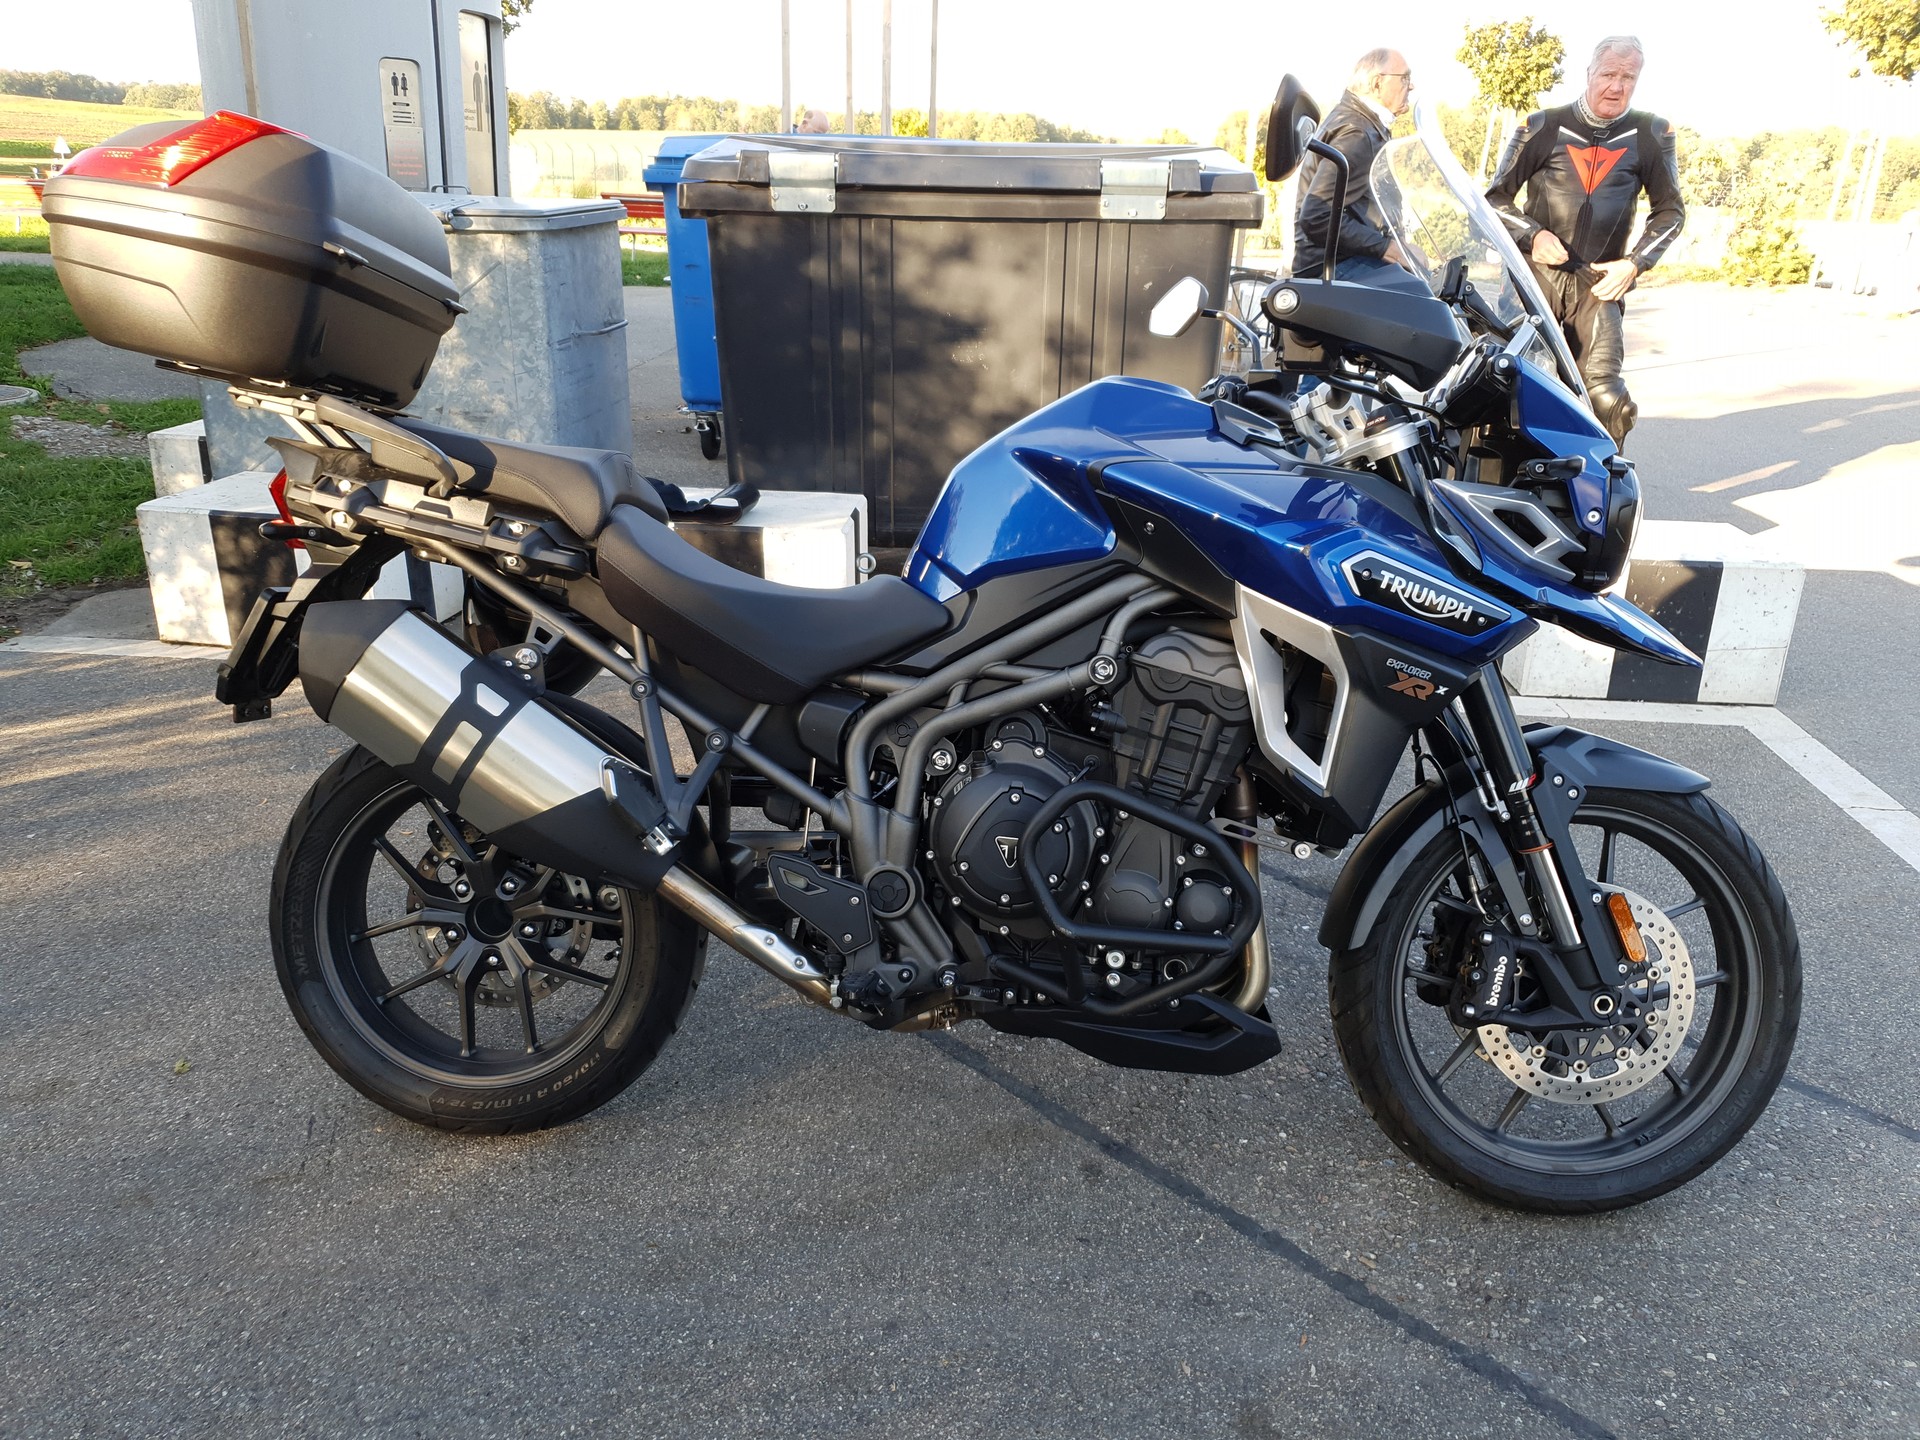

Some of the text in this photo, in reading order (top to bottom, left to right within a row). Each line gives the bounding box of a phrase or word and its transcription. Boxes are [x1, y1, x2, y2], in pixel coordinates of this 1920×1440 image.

[1380, 570, 1473, 622] TRIUMPH
[1386, 657, 1432, 681] EXPLORER
[1485, 955, 1508, 1007] brembo
